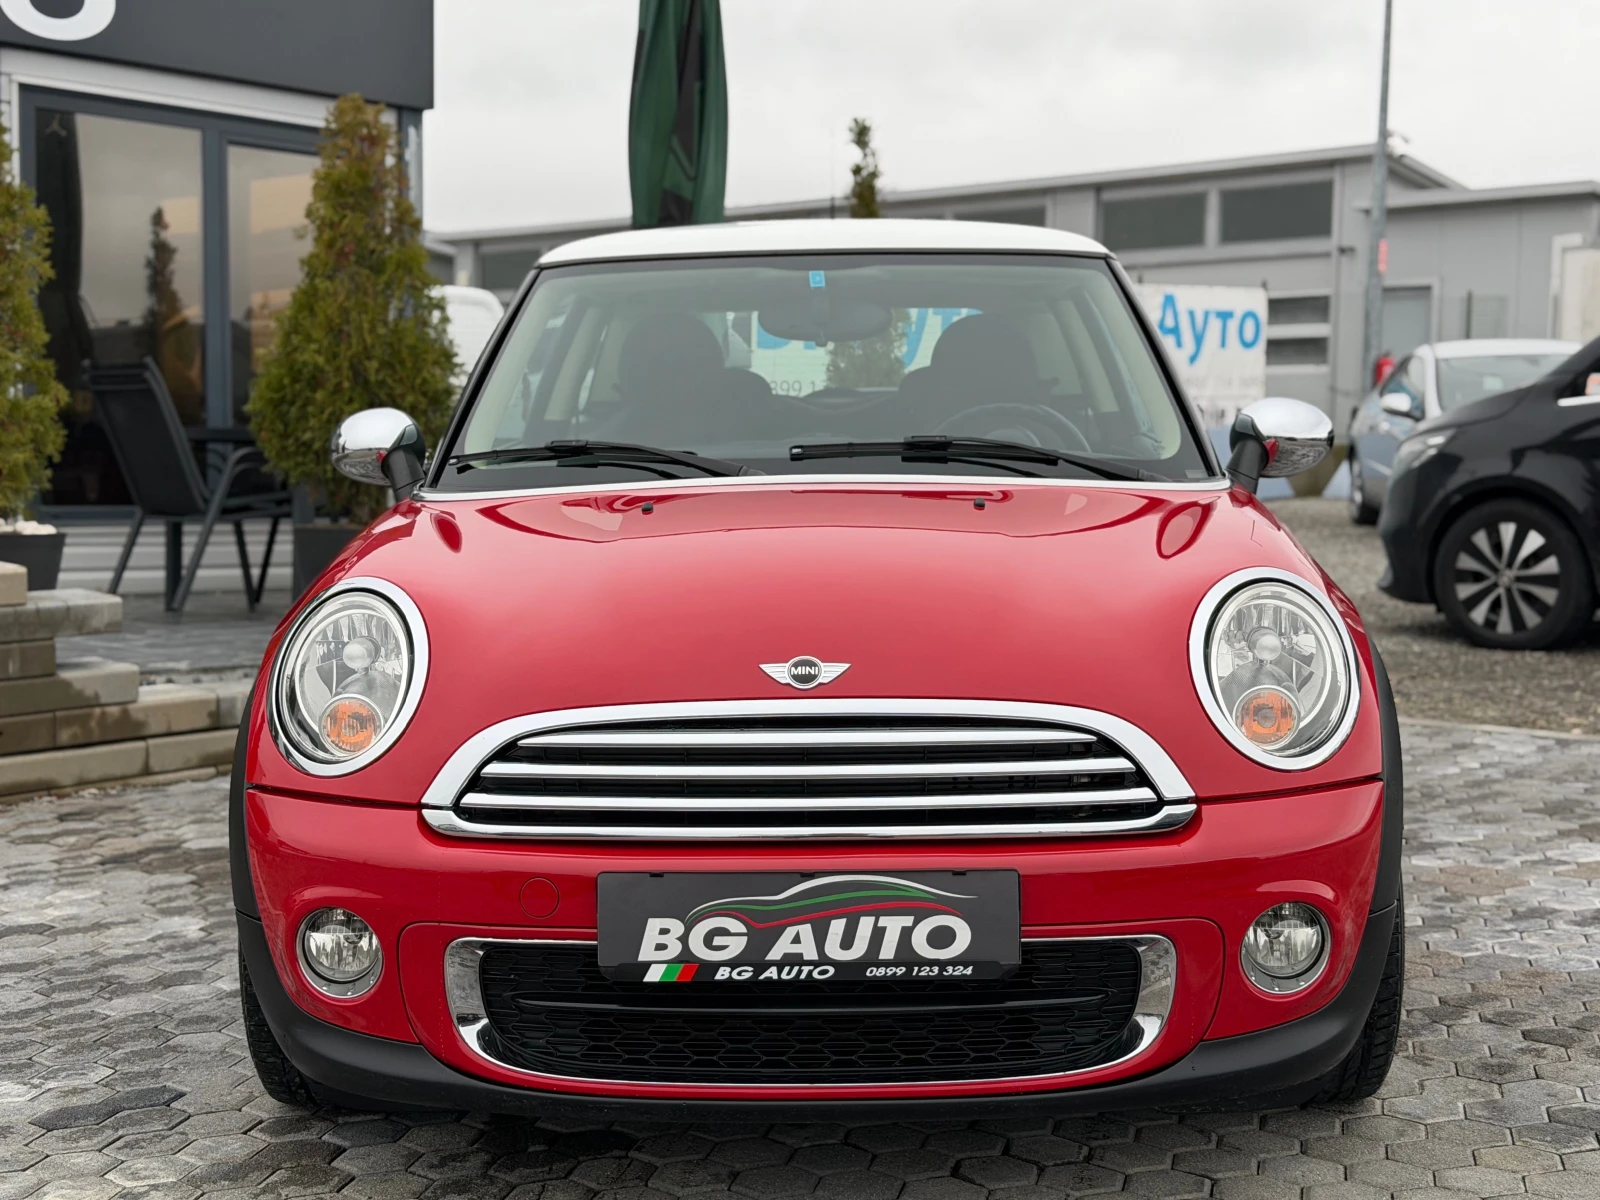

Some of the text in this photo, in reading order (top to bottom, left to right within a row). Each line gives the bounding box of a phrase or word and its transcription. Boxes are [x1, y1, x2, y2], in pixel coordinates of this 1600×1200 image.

[1158, 293, 1261, 366] Ауто
[790, 665, 819, 676] MINI
[638, 914, 972, 962] BG AUTO
[713, 965, 974, 980] BG AUTO 0899 123 324
